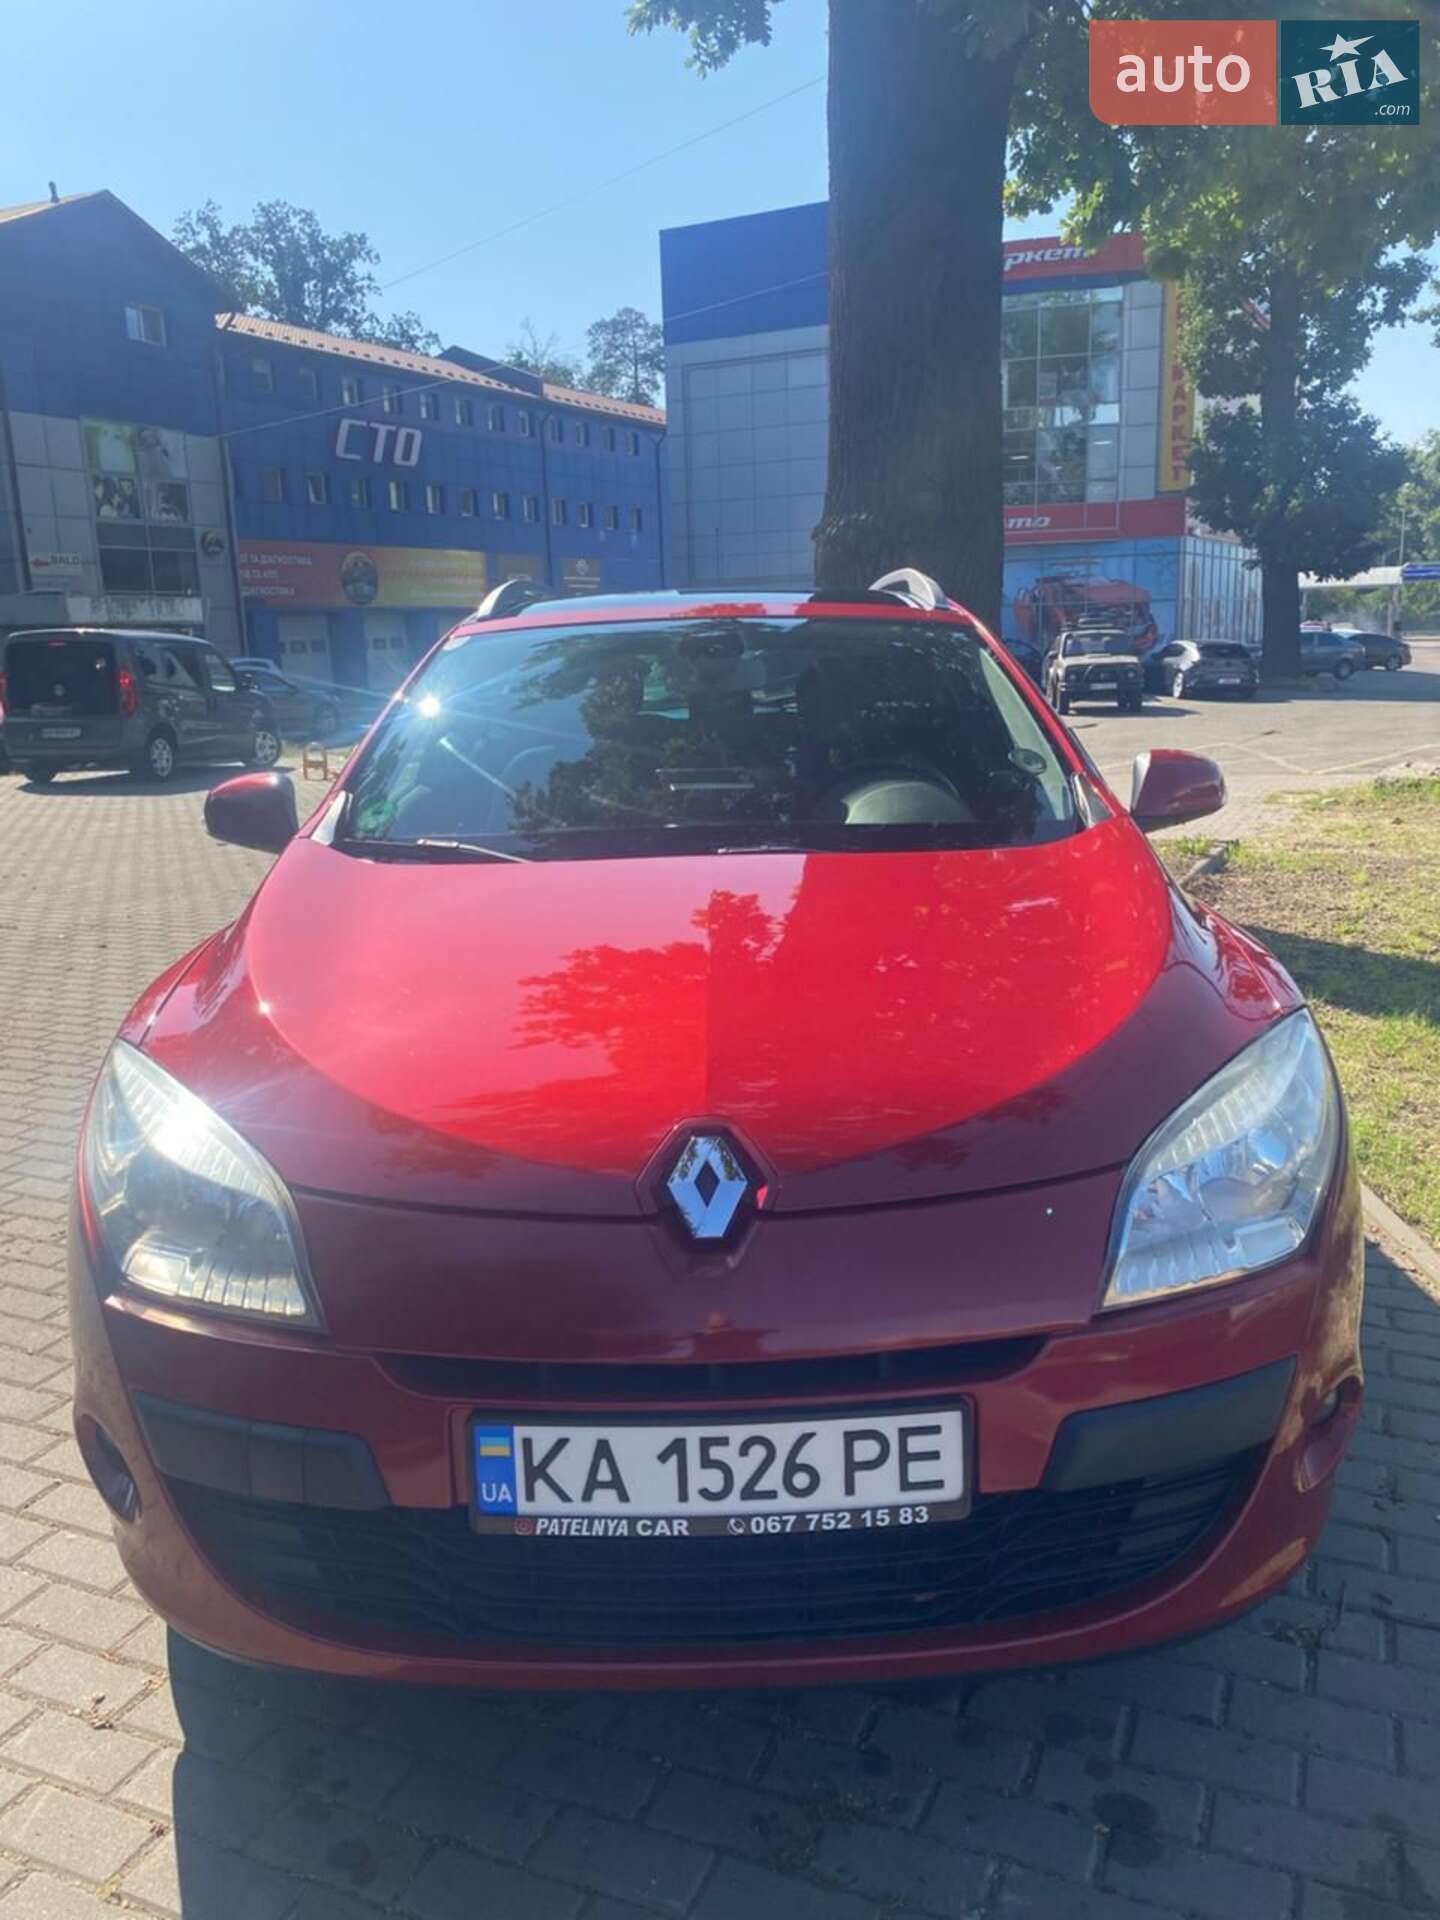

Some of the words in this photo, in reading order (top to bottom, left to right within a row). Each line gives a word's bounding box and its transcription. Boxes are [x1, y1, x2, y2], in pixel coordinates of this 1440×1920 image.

[336, 418, 422, 467] СТО
[521, 1437, 631, 1503] KA
[656, 1431, 821, 1504] 1526
[843, 1424, 945, 1497] PE
[482, 1482, 513, 1503] UA
[535, 1518, 629, 1537] PATELNYA
[636, 1519, 690, 1536] CAR
[751, 1515, 798, 1535] 067
[806, 1511, 851, 1531] 752
[861, 1508, 891, 1527] 15
[898, 1506, 930, 1525] 83
